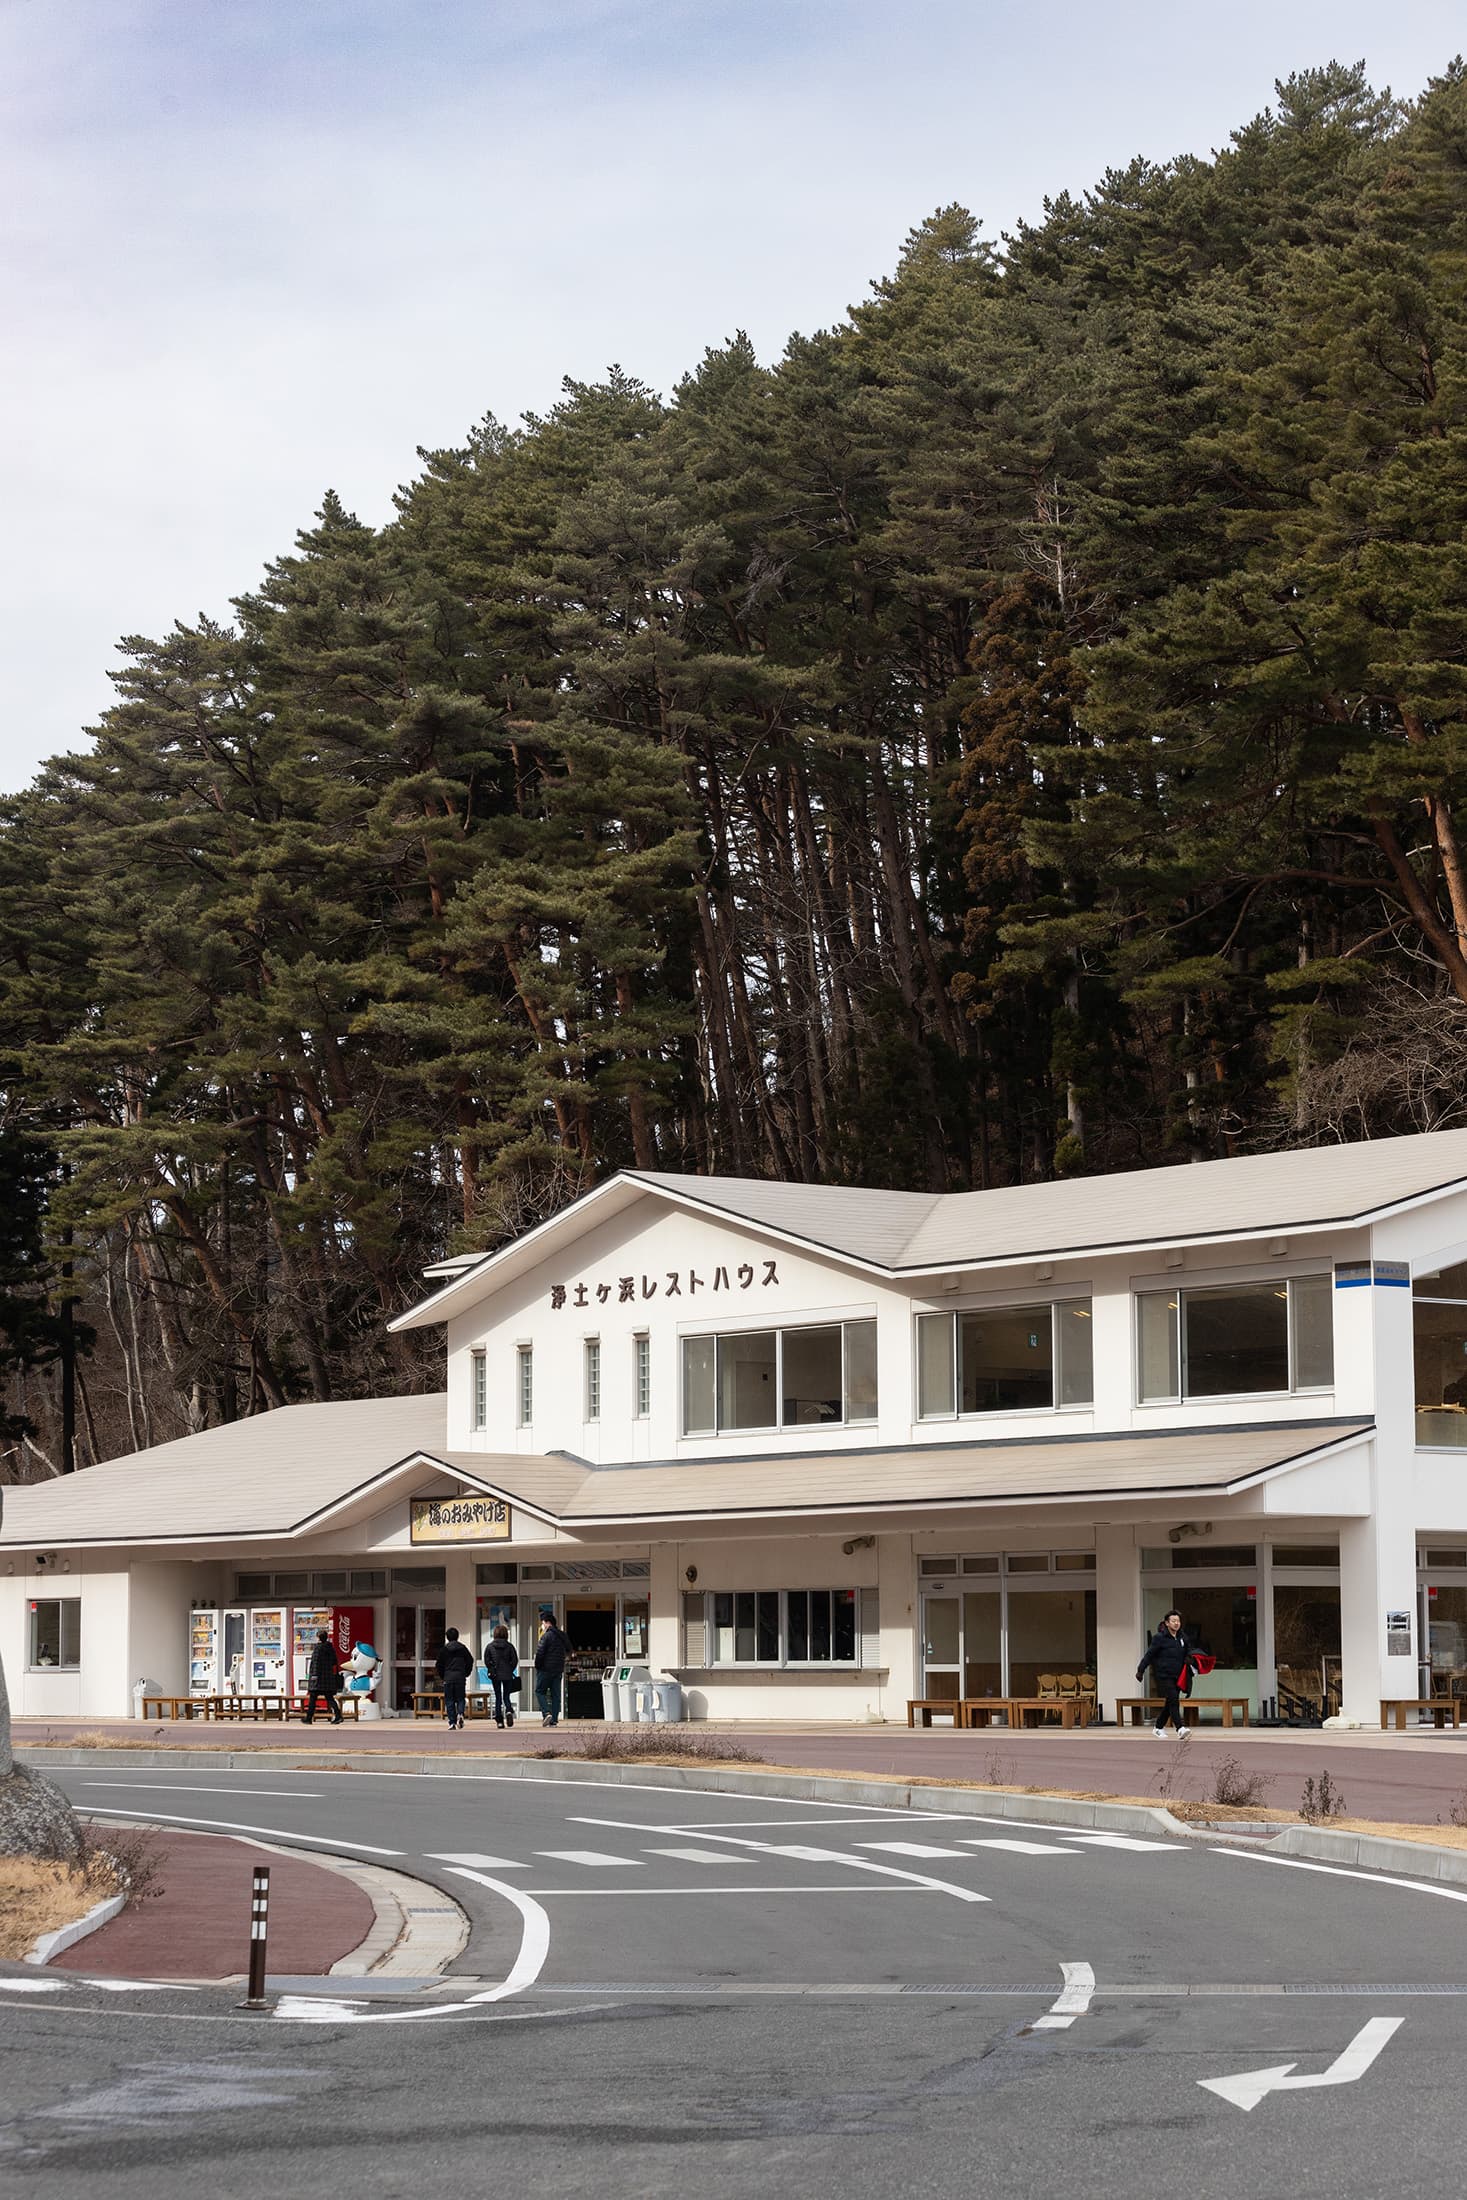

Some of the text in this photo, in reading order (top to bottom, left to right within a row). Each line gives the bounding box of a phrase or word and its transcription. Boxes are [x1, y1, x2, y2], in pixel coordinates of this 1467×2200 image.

[429, 1501, 506, 1526] 海のおみやげ店
